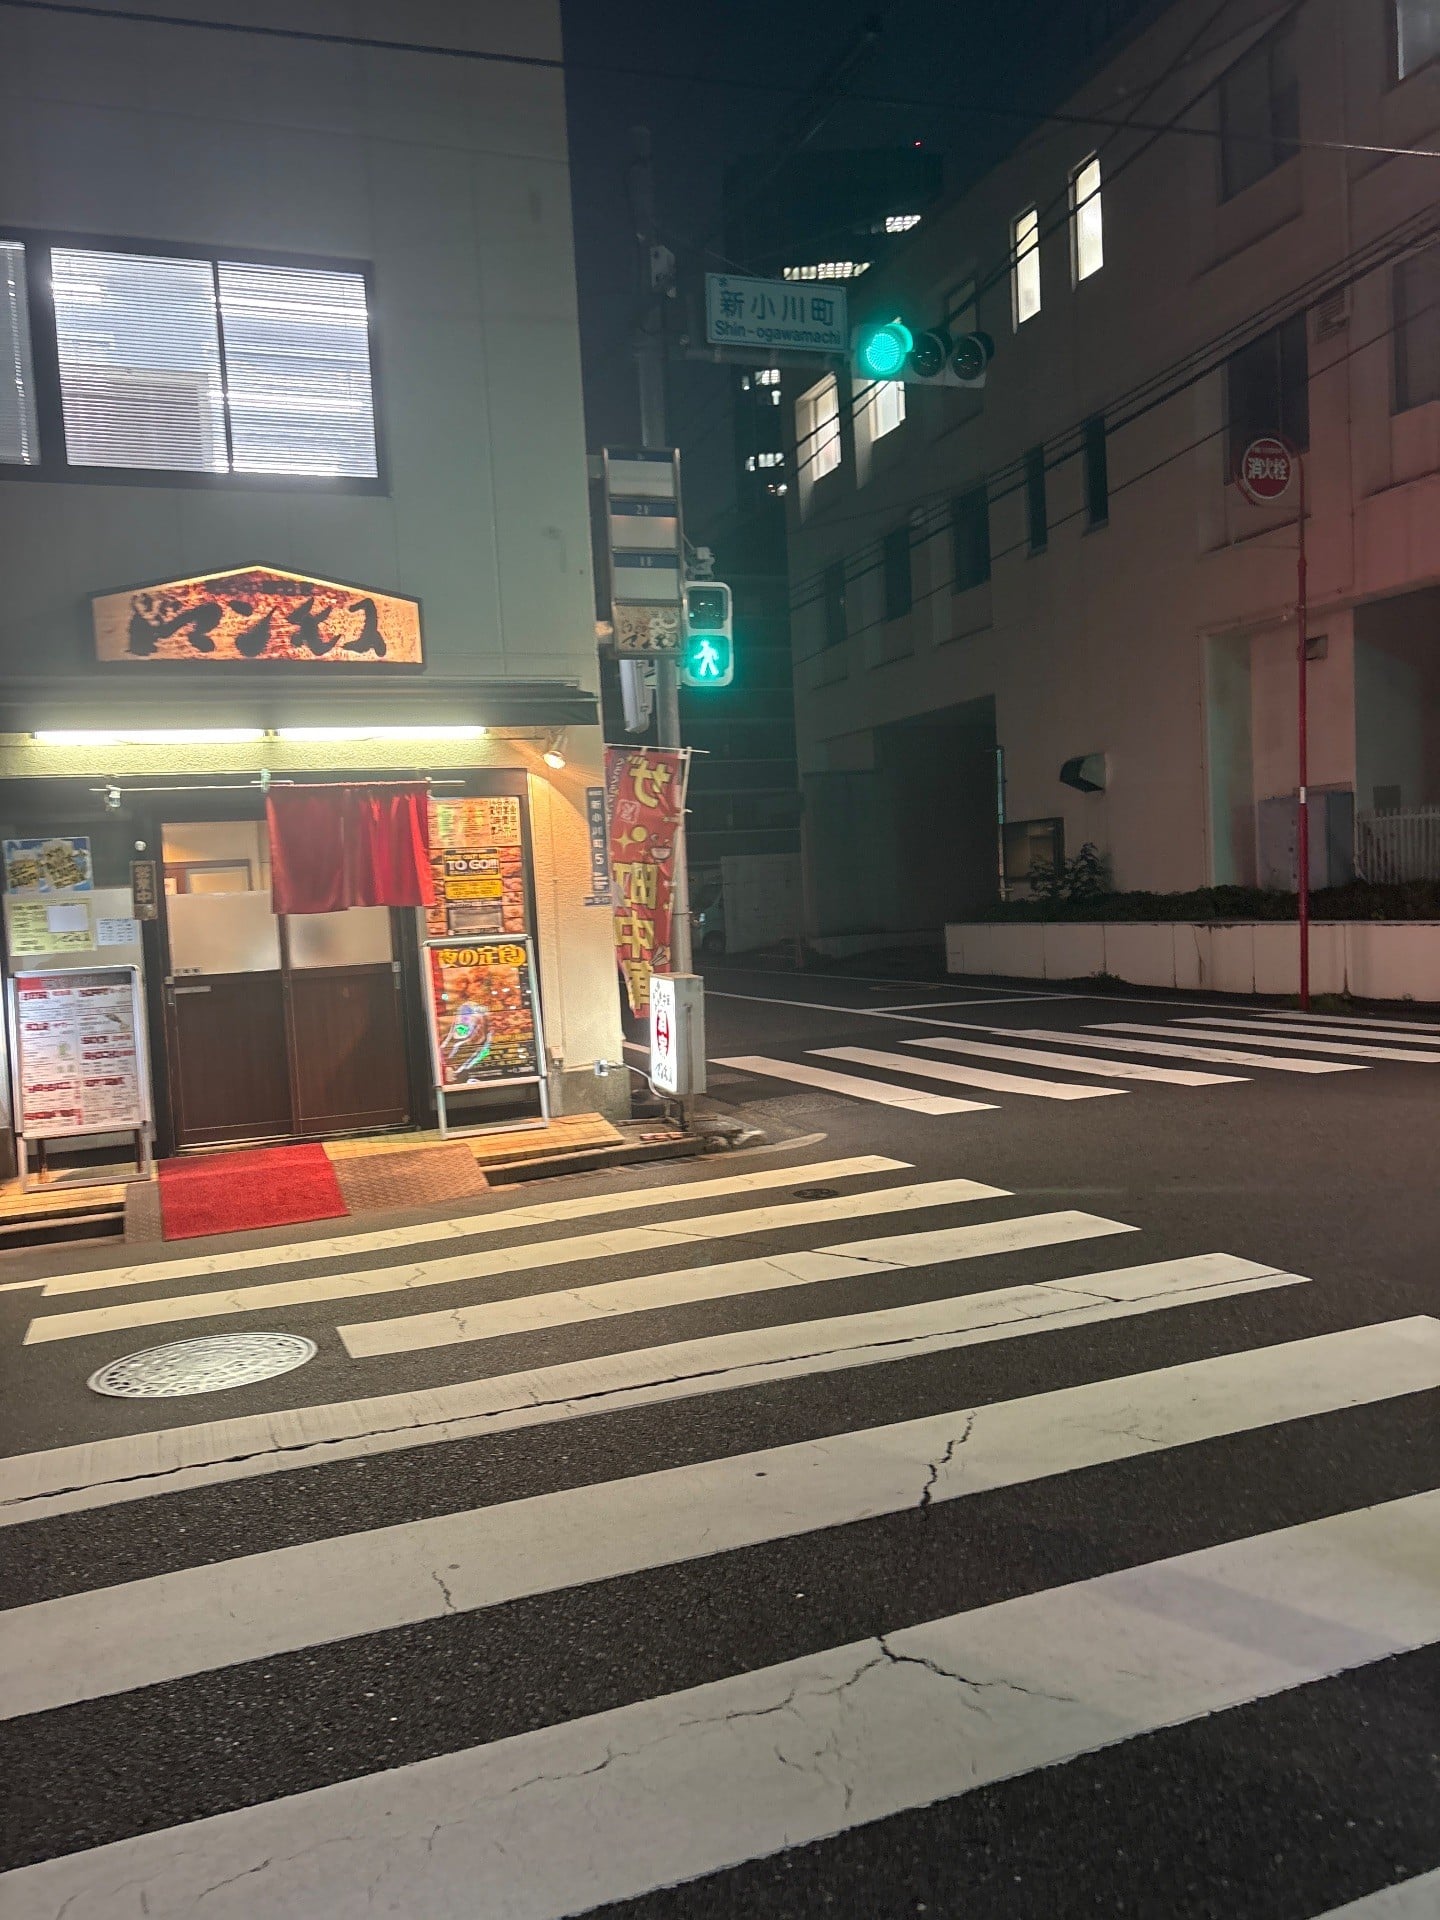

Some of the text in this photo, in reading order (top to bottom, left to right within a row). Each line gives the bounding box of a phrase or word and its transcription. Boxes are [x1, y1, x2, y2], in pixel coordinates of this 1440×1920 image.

[719, 289, 835, 327] 新小川町
[714, 319, 841, 345] Shin-ogawamachi
[1247, 457, 1288, 481] 消火栓
[446, 860, 468, 871] TO
[438, 943, 527, 968] 夜の定食
